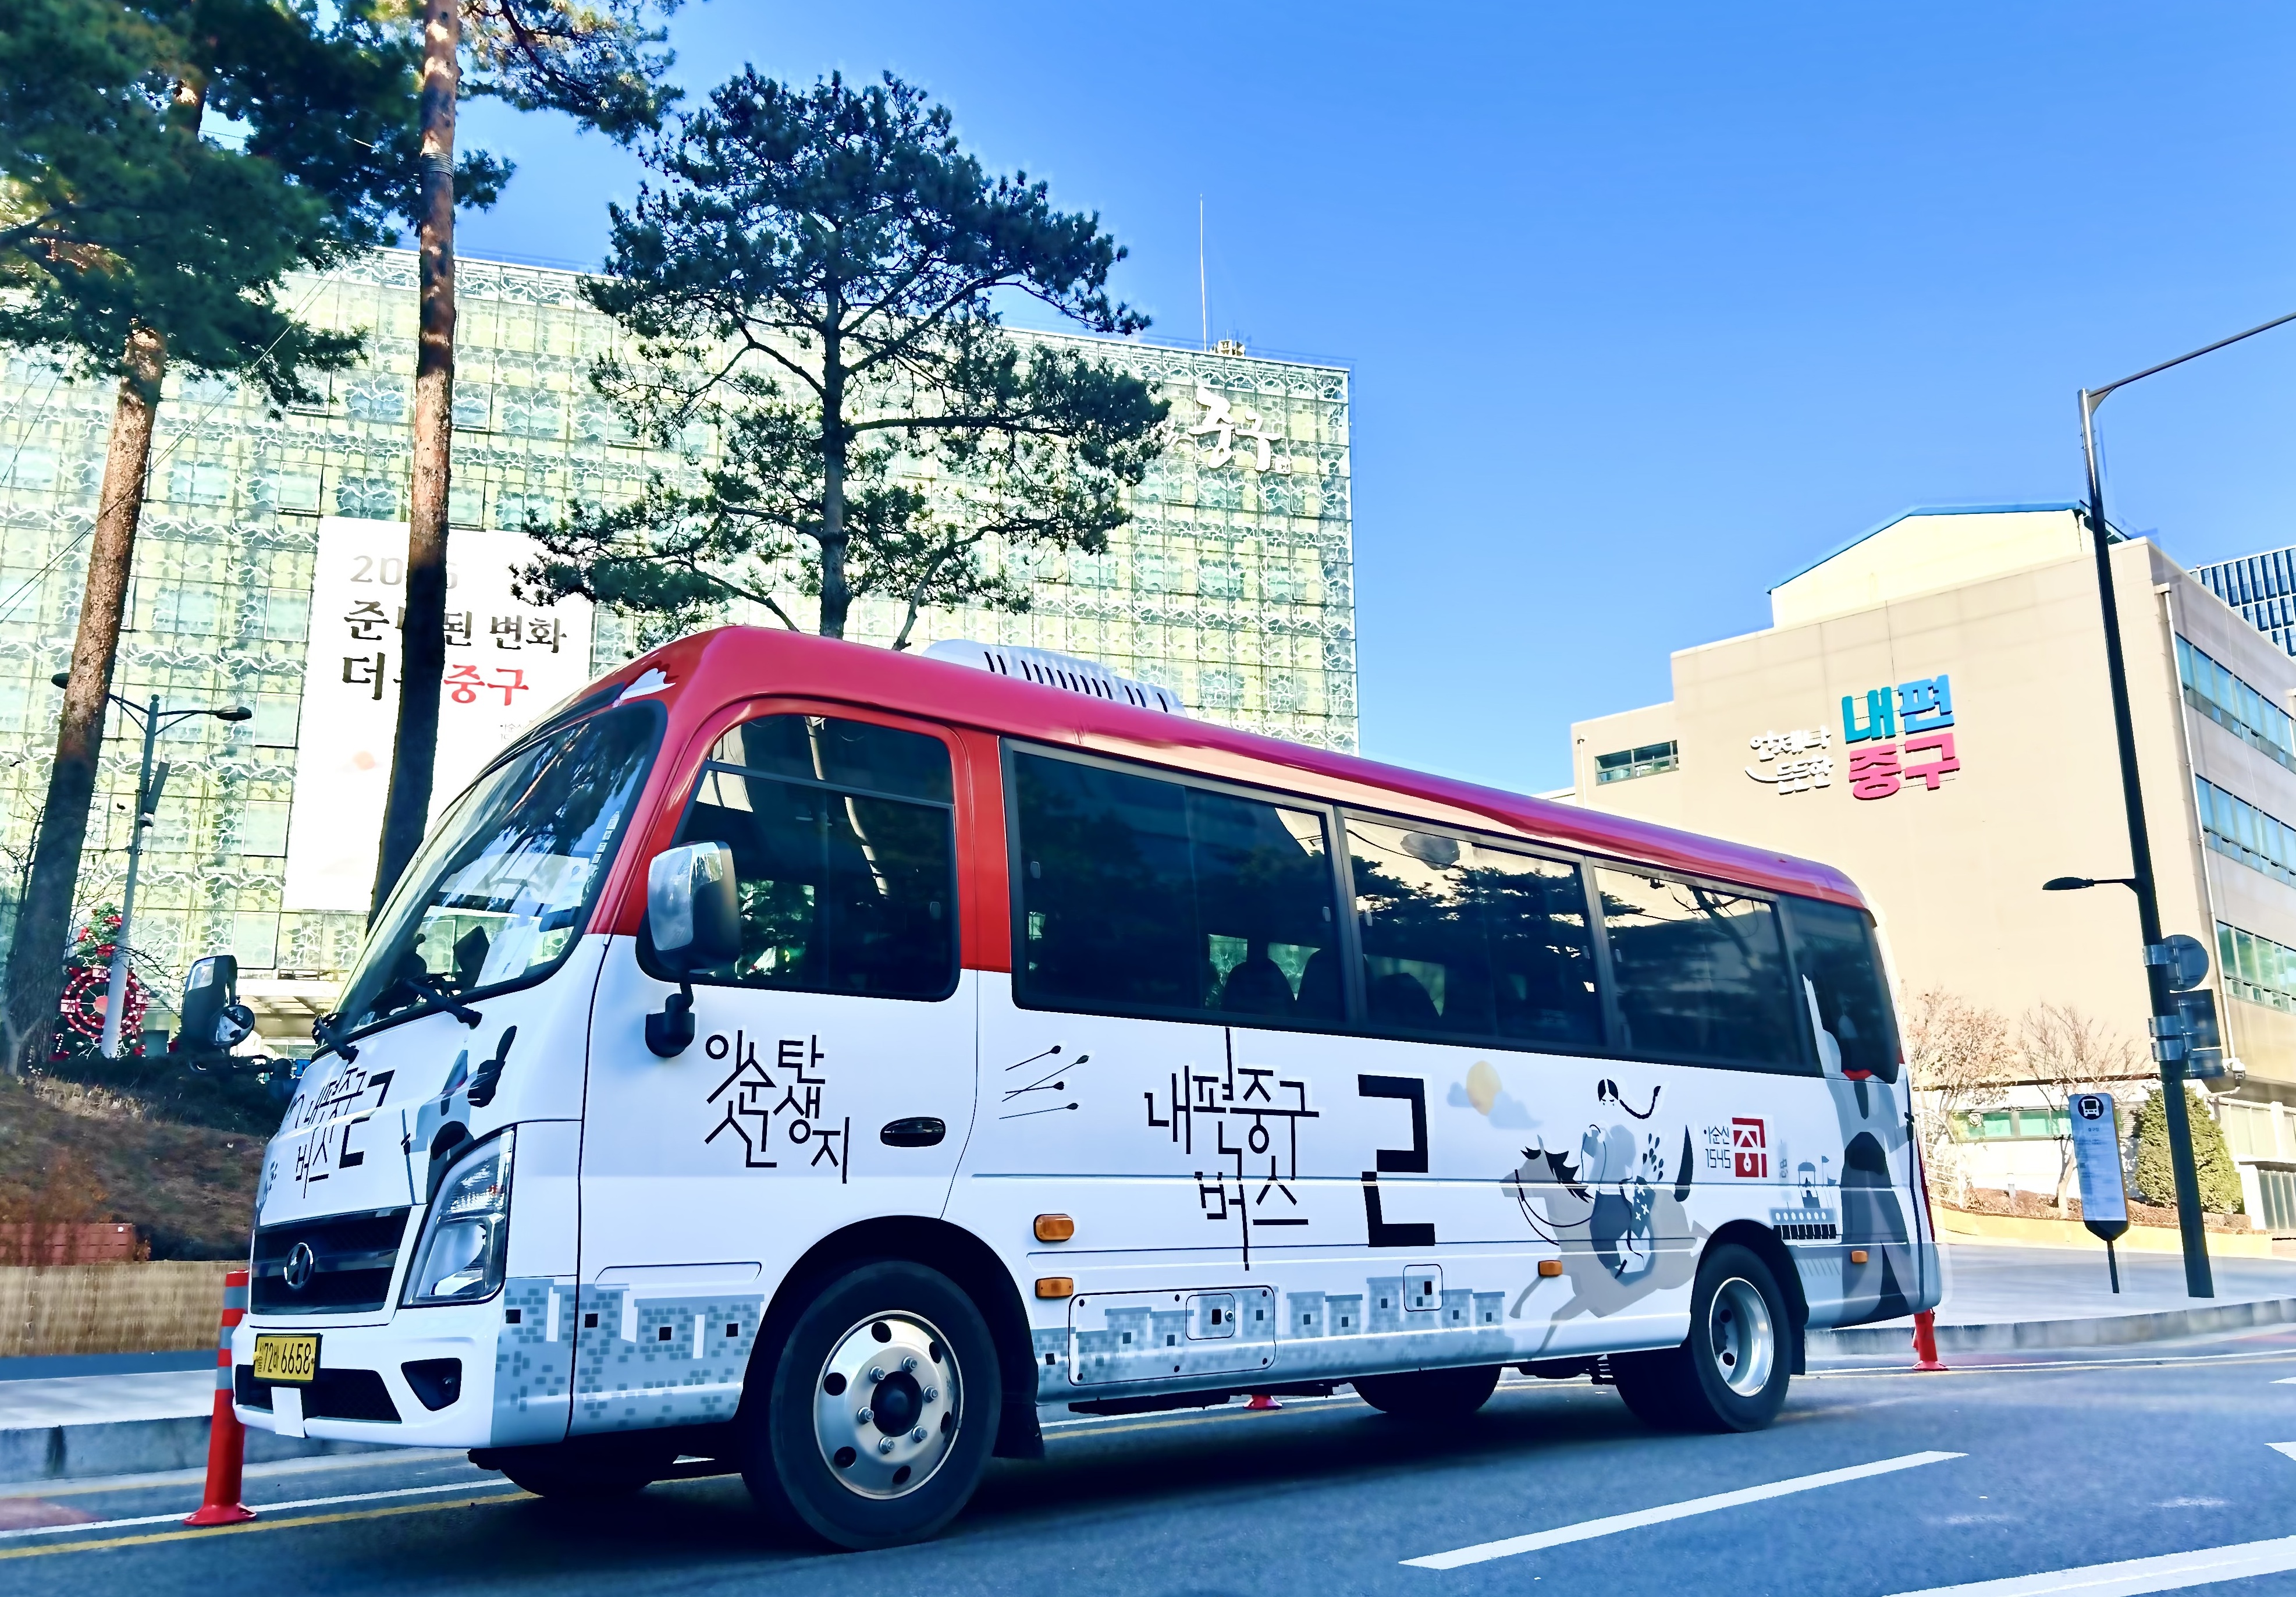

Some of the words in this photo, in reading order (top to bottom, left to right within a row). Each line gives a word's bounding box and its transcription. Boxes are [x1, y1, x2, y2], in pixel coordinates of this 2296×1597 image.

[343, 600, 472, 647] 준된
[489, 615, 567, 653] 변화
[444, 664, 529, 706] 중구
[1842, 674, 1955, 744] 내편
[1776, 754, 1834, 796] 든든한
[1849, 733, 1960, 801] 중구
[1705, 1148, 1731, 1168] 1545
